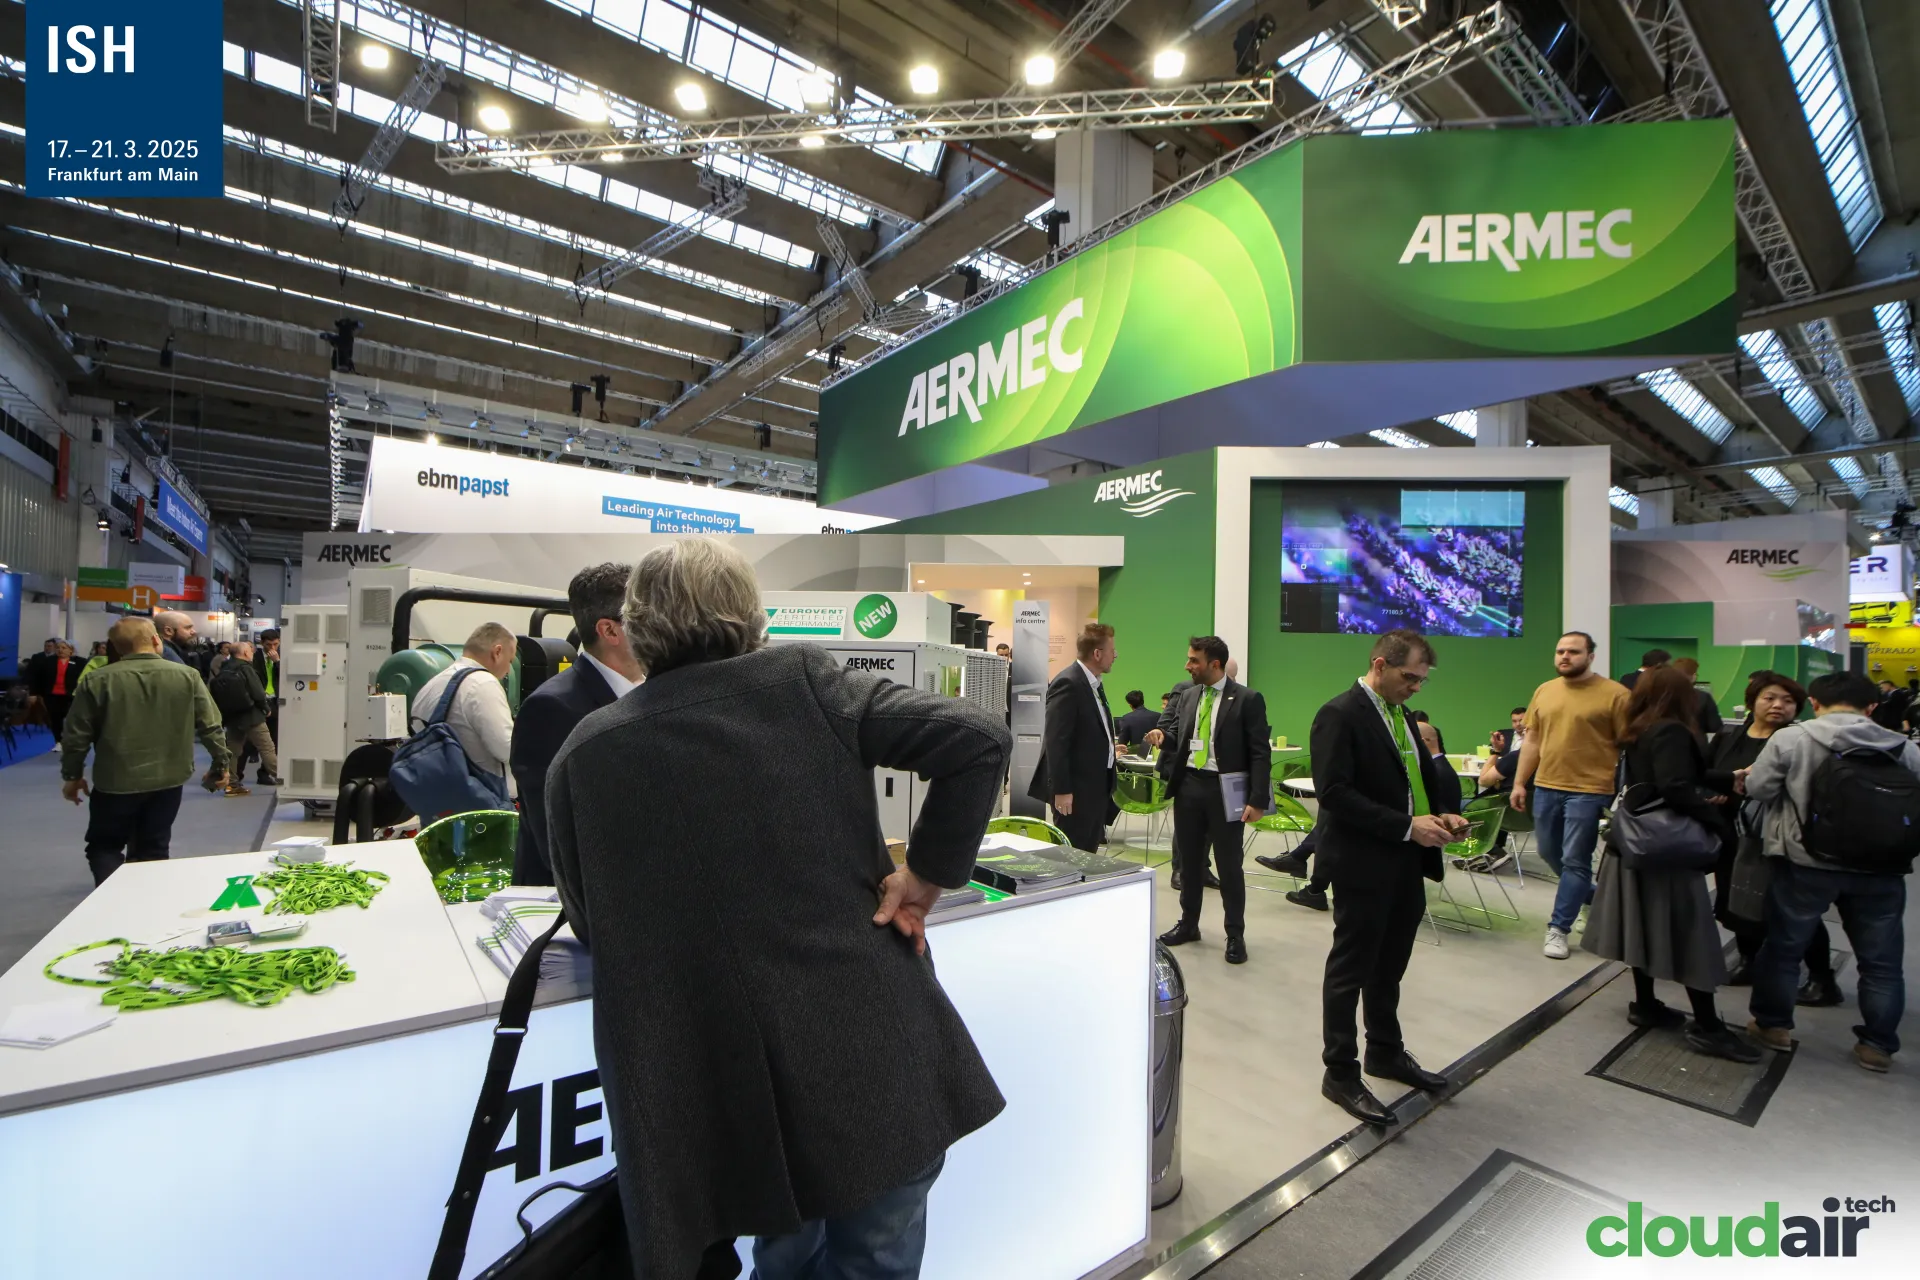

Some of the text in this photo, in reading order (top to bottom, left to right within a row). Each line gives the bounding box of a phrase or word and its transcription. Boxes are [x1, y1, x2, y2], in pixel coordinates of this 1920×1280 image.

[1398, 208, 1633, 272] AERMEC
[898, 297, 1084, 437] AERMEC
[417, 467, 510, 498] ebmpapst
[1093, 469, 1163, 503] AERMEC
[607, 500, 736, 528] Leading Air Technology
[656, 520, 679, 533] into
[681, 524, 700, 534] the
[317, 544, 392, 566] AERMEC
[1726, 549, 1800, 568] AERMEC
[857, 601, 893, 633] NEW
[846, 657, 895, 672] AERMEC
